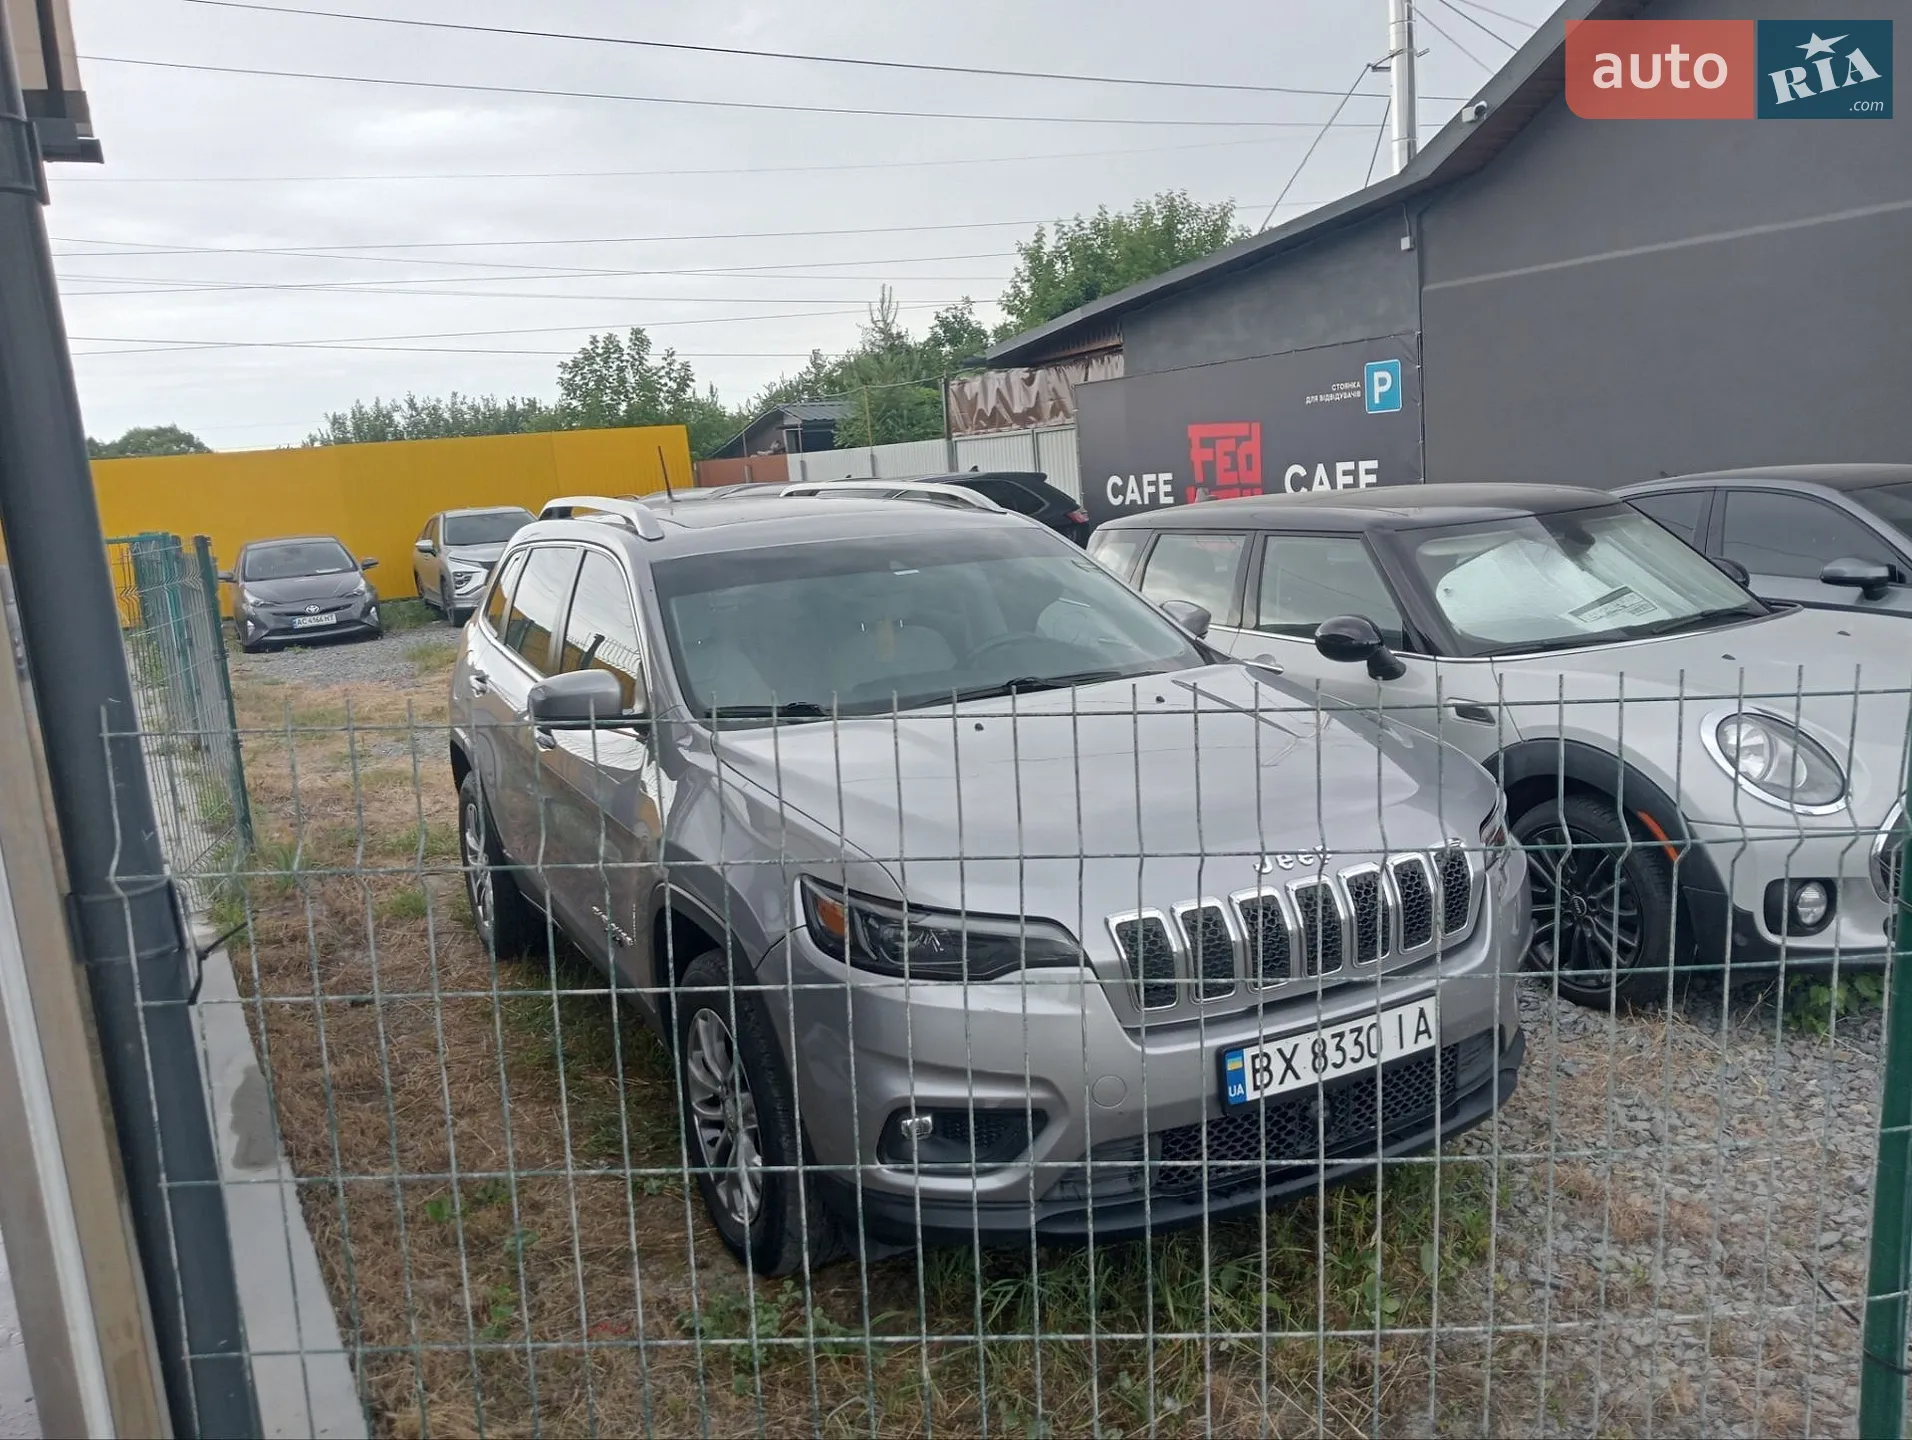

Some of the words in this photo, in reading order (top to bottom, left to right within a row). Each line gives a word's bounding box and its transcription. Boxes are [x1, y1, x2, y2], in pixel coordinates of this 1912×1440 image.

[1373, 371, 1392, 404] P
[1106, 473, 1174, 506] CAFE
[1283, 460, 1379, 493] CAFE
[1250, 1043, 1301, 1092] BX
[1311, 1022, 1382, 1075] 8330
[1398, 1006, 1432, 1050] IA
[1228, 1083, 1244, 1098] UA
